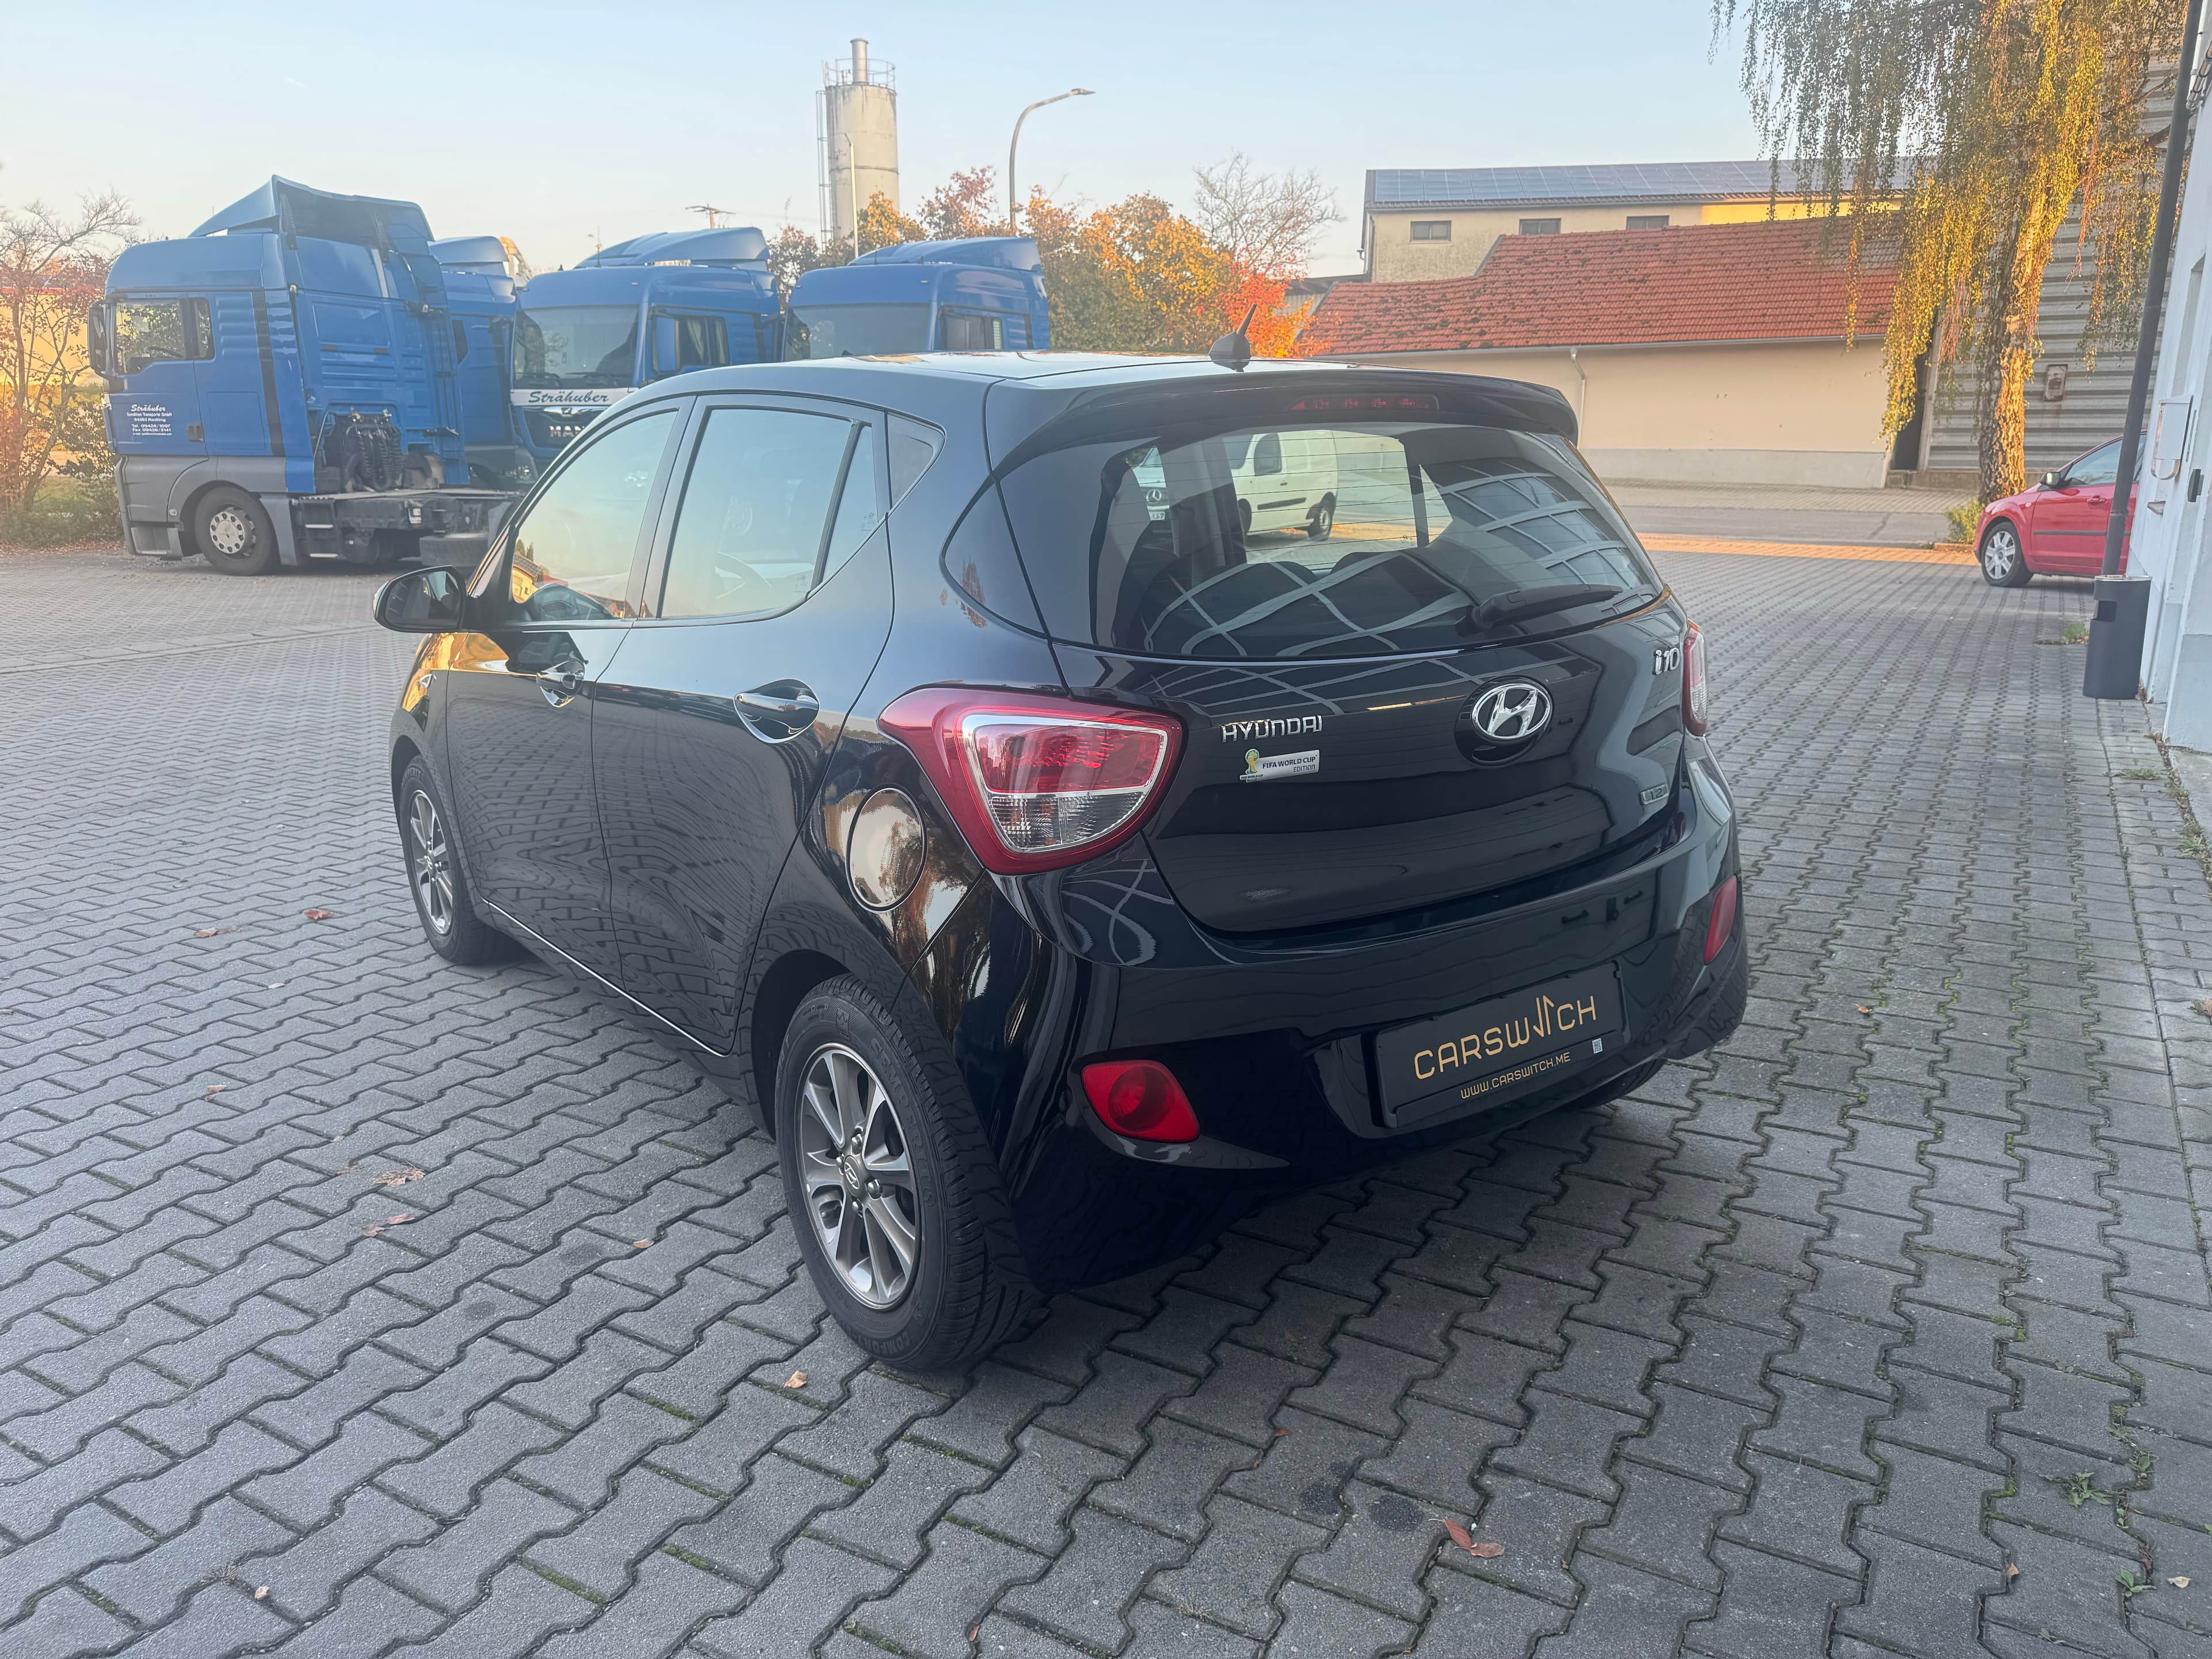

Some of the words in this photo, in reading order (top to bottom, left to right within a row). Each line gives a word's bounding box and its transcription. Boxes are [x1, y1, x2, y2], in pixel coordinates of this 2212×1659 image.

[528, 391, 609, 403] Strähuber
[1654, 647, 1680, 675] i10
[1221, 715, 1323, 743] HYUNDAI
[1278, 758, 1302, 767] WORLD
[1293, 764, 1316, 773] EDITION
[1414, 995, 1597, 1080] CARSWITCH
[1460, 1052, 1571, 1099] WWW.CARSWITCH.ME
[869, 1037, 932, 1182] SEMPERIT
